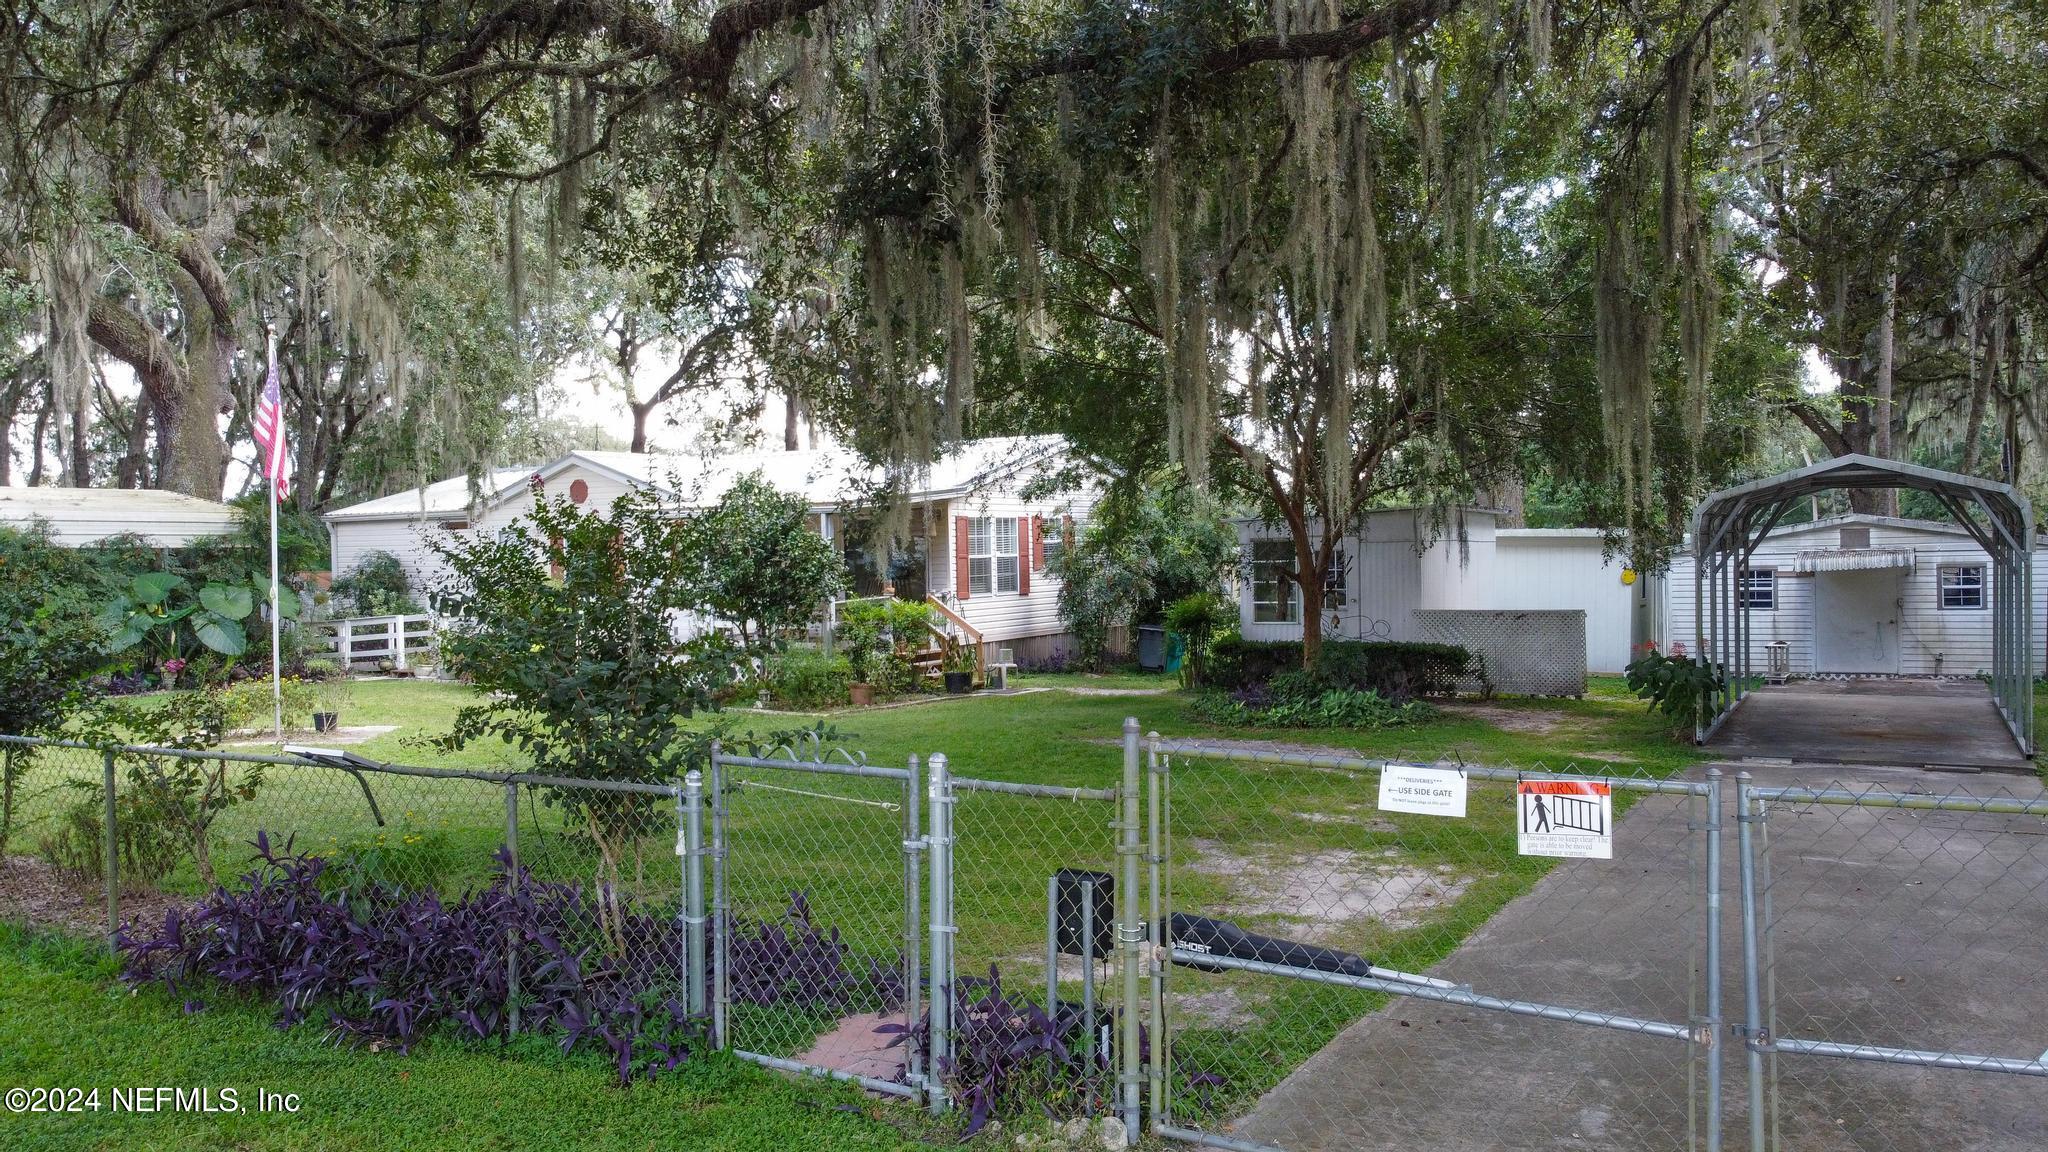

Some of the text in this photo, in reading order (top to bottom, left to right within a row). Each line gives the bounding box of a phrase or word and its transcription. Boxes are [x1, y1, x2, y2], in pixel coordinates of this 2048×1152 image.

[1398, 787, 1453, 798] USE SIDE GATE
[1566, 834, 1579, 843] keep
[1573, 842, 1593, 850] moved
